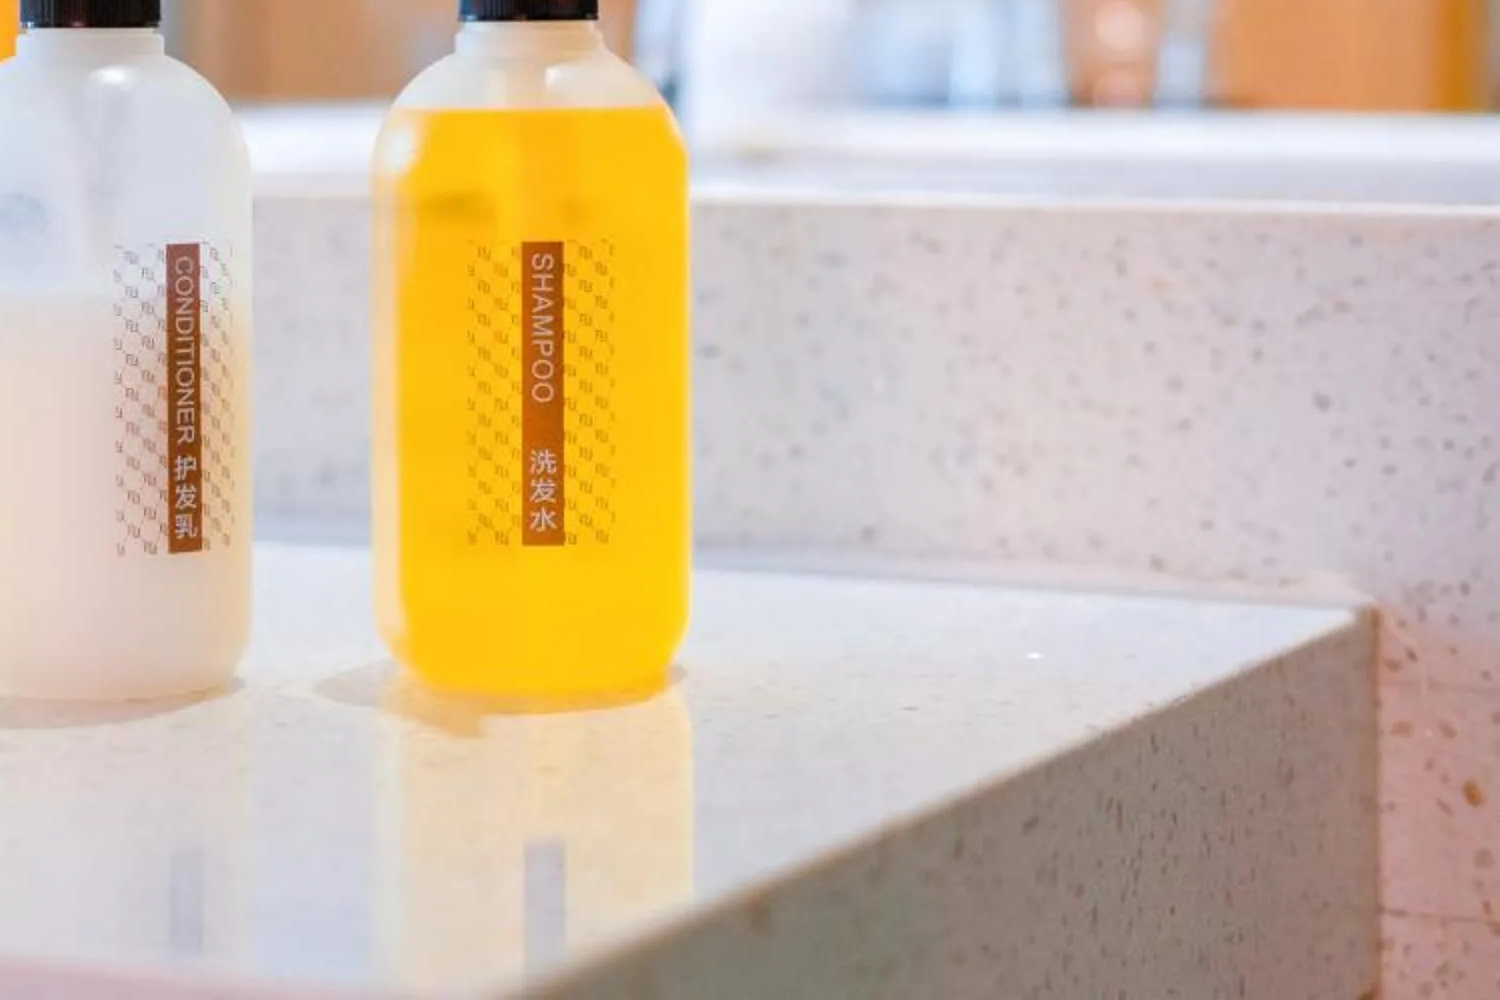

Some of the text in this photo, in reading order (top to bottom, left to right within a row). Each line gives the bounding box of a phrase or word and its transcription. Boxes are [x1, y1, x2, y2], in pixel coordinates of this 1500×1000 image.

[174, 255, 196, 445] CONDITIONER
[531, 252, 555, 404] SHAMPOO
[174, 455, 197, 540] 护发乳
[529, 449, 558, 532] 洗发水
